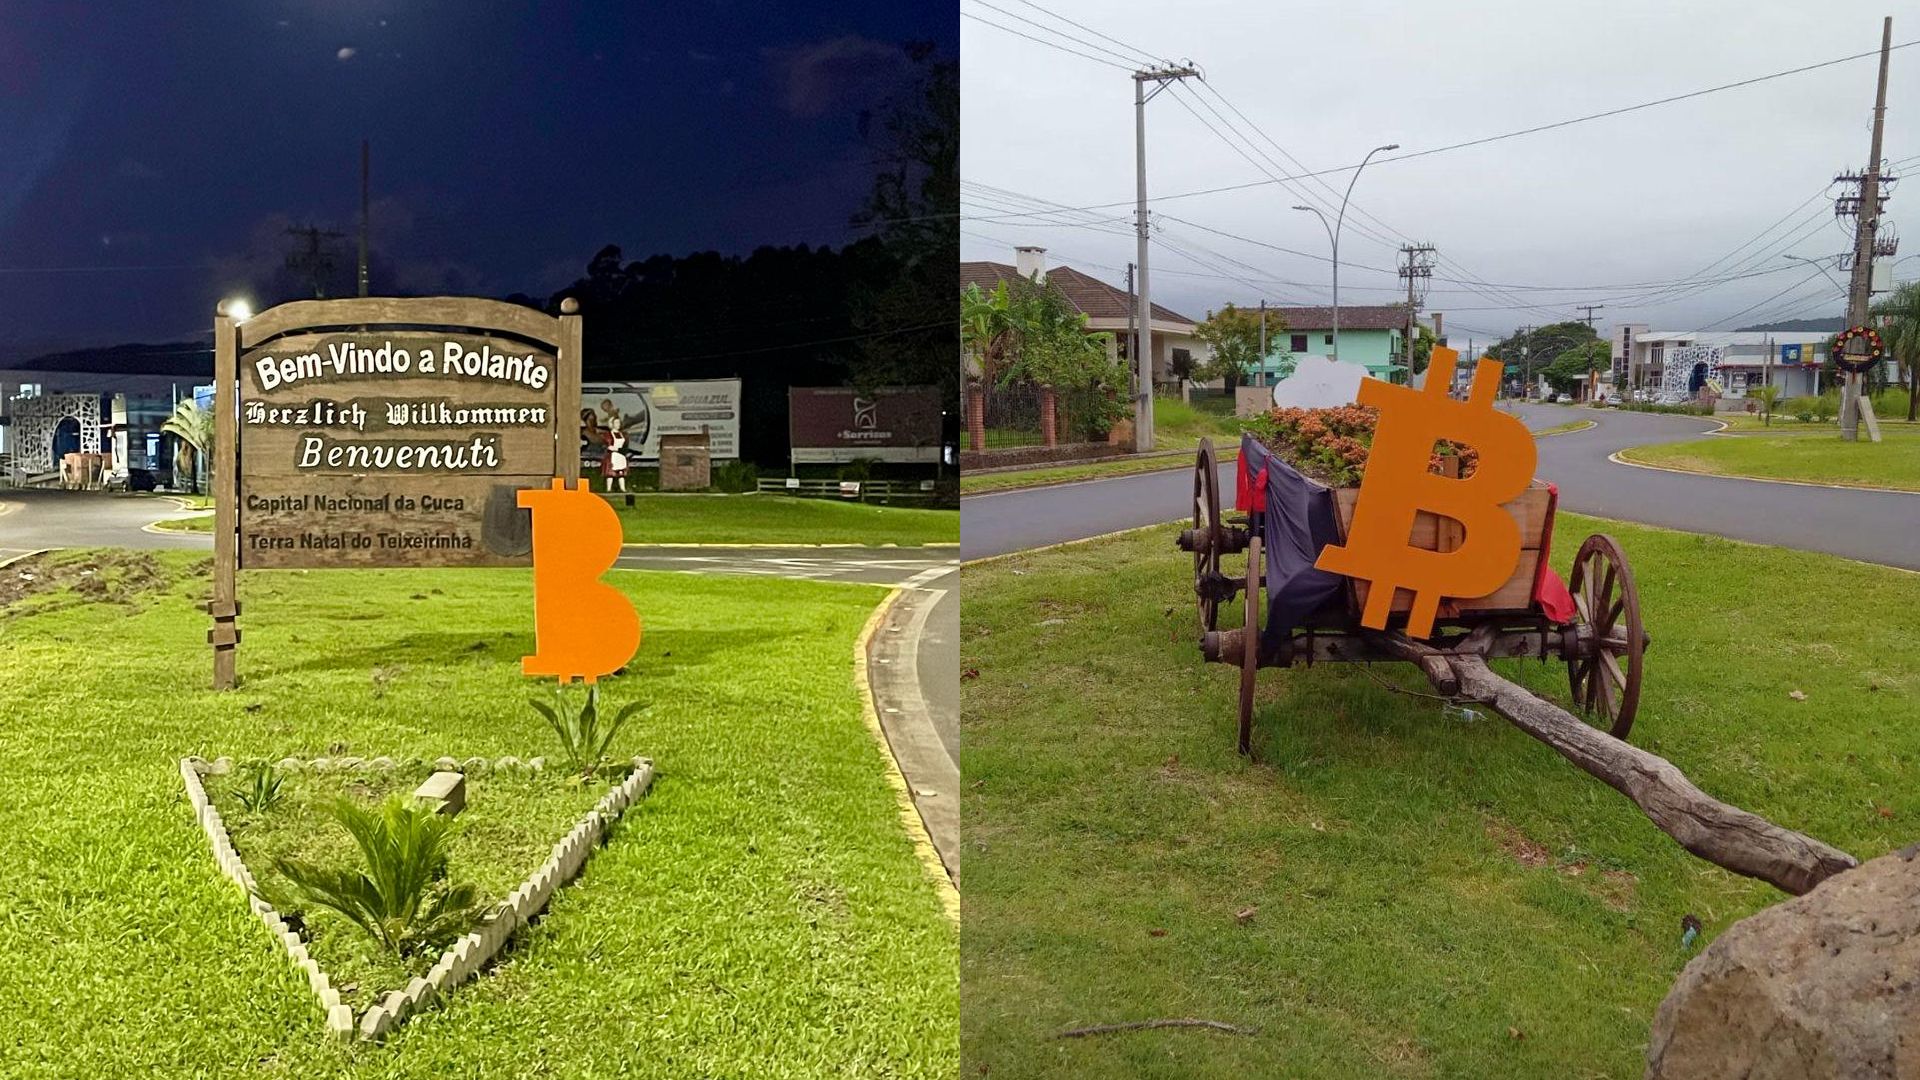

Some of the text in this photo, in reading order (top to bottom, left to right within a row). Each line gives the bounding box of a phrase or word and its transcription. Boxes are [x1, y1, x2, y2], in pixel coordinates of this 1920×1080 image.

[256, 341, 548, 390] Bem-Vindo a Rolante
[245, 402, 547, 431] Herzlich Willkommen
[299, 437, 498, 469] Benvenuti
[247, 494, 464, 515] Capital Nacional da Cuca
[248, 532, 472, 549] Terra Natal do Teixeirinha
